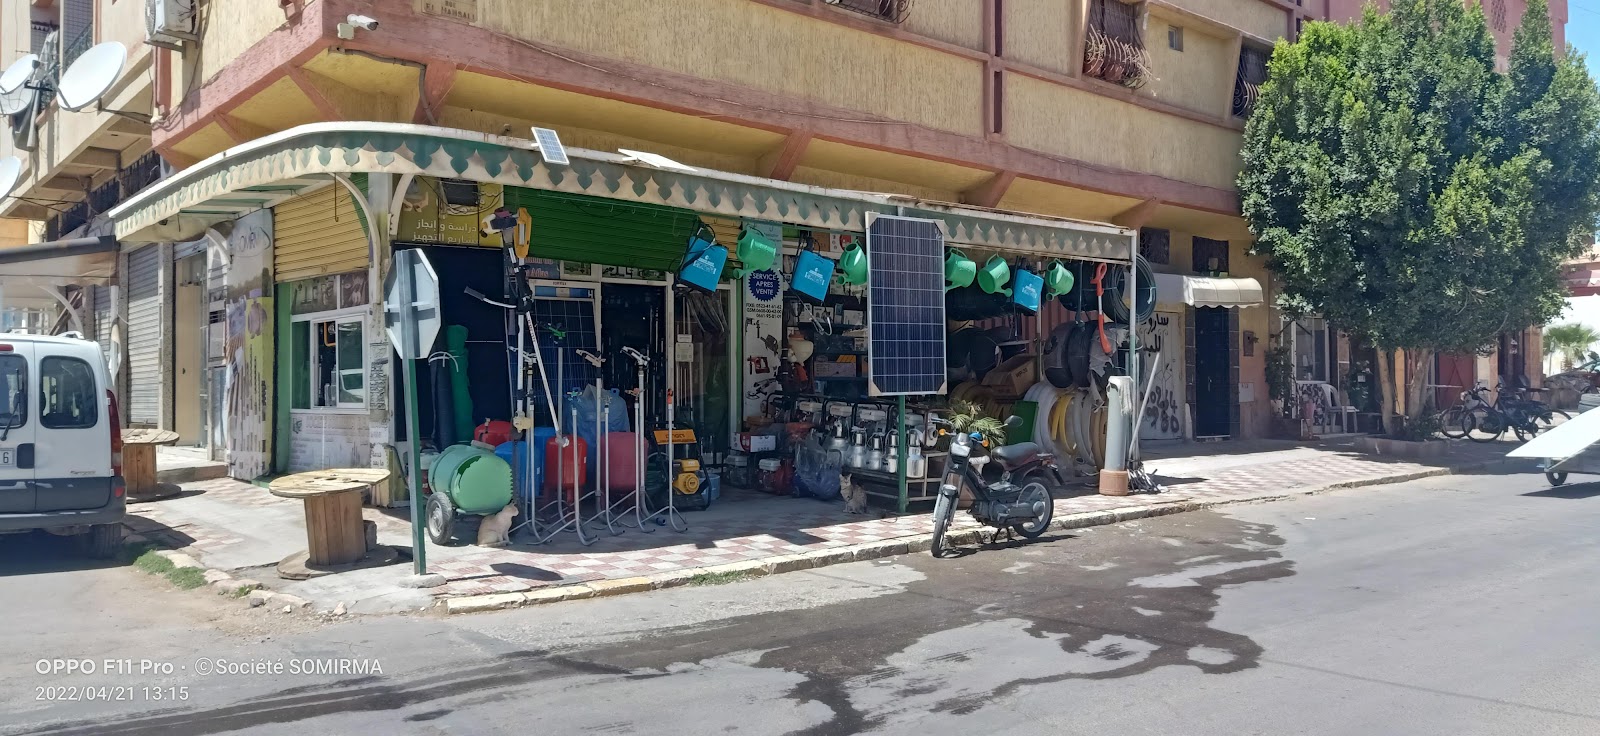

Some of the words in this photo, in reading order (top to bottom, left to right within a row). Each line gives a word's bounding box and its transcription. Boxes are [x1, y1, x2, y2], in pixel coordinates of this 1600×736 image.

[416, 219, 437, 231] إنجاز
[439, 223, 446, 231] و
[448, 223, 477, 233] دراسة
[412, 231, 445, 243] التجهيز
[753, 272, 776, 281] SERVICE
[2, 451, 9, 464] 6
